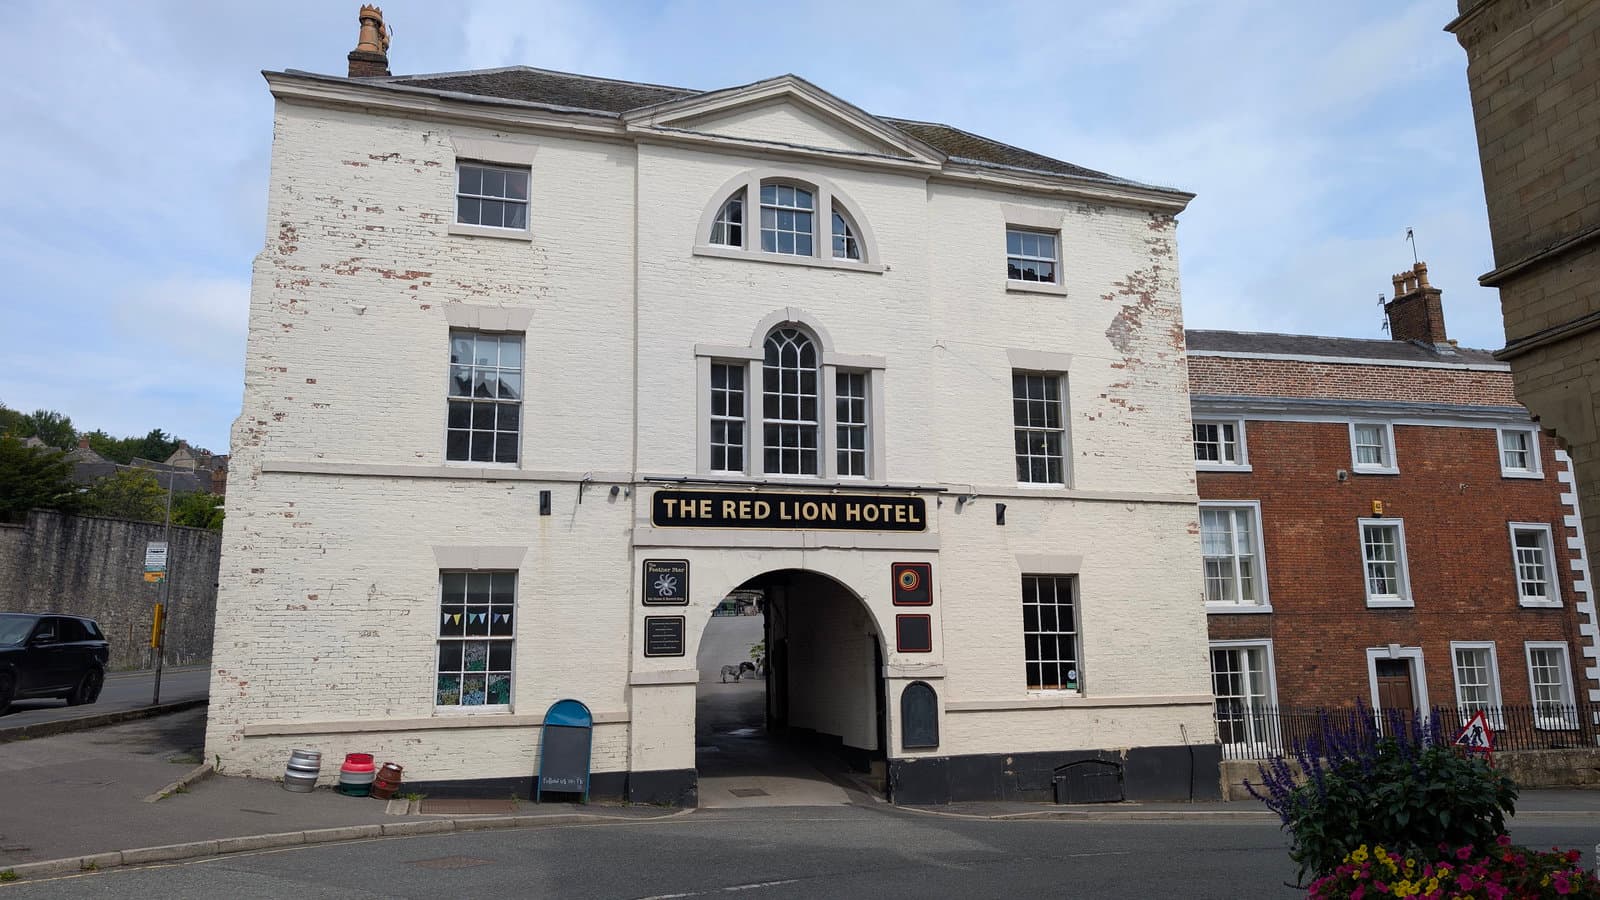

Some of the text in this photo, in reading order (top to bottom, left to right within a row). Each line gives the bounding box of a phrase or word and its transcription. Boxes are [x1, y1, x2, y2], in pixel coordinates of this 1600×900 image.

[662, 499, 920, 523] THE RED LION HOTEL
